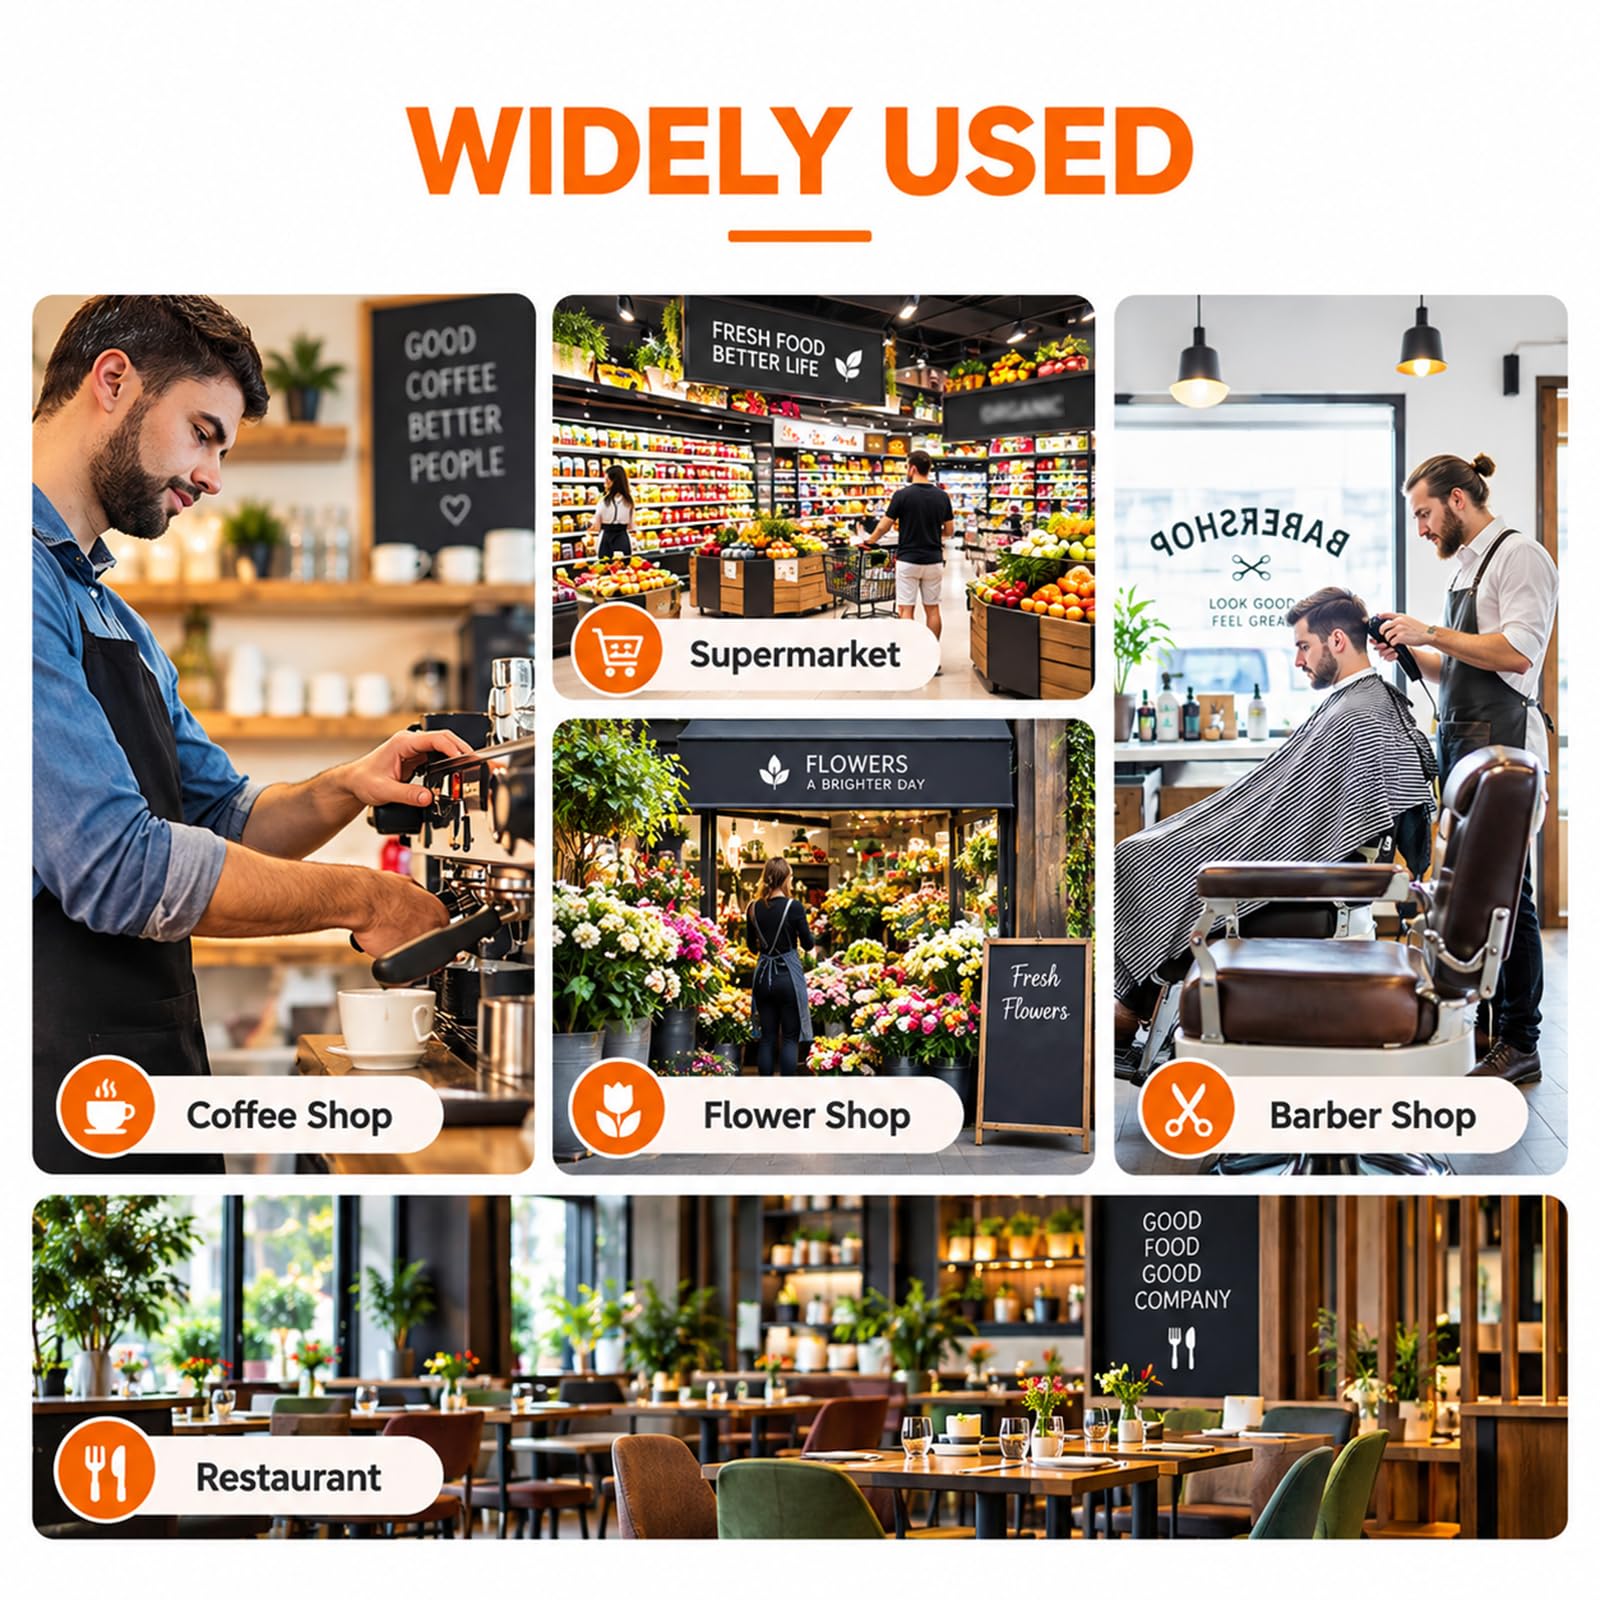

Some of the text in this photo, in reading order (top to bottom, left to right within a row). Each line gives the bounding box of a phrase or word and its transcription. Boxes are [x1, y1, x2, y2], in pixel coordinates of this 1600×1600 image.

[404, 324, 478, 361] GOOD
[712, 320, 826, 357] FRESH FOOD
[712, 344, 819, 378] BETTER LIFE
[405, 361, 498, 401] COFFEE
[407, 403, 503, 443] BETTER
[409, 445, 505, 483] PEOPLE
[1208, 597, 1248, 610] LOOK
[1212, 614, 1292, 628] FEEL GREA
[806, 754, 908, 774] FLOWERS
[807, 778, 926, 791] A BRIGHTER DAY
[1010, 963, 1062, 988] Fresh
[1001, 996, 1071, 1021] Flowers
[1142, 1210, 1202, 1232] GOOD
[1144, 1236, 1200, 1257] FOOD
[1142, 1262, 1202, 1284] GOOD
[1134, 1289, 1232, 1311] COMPANY
